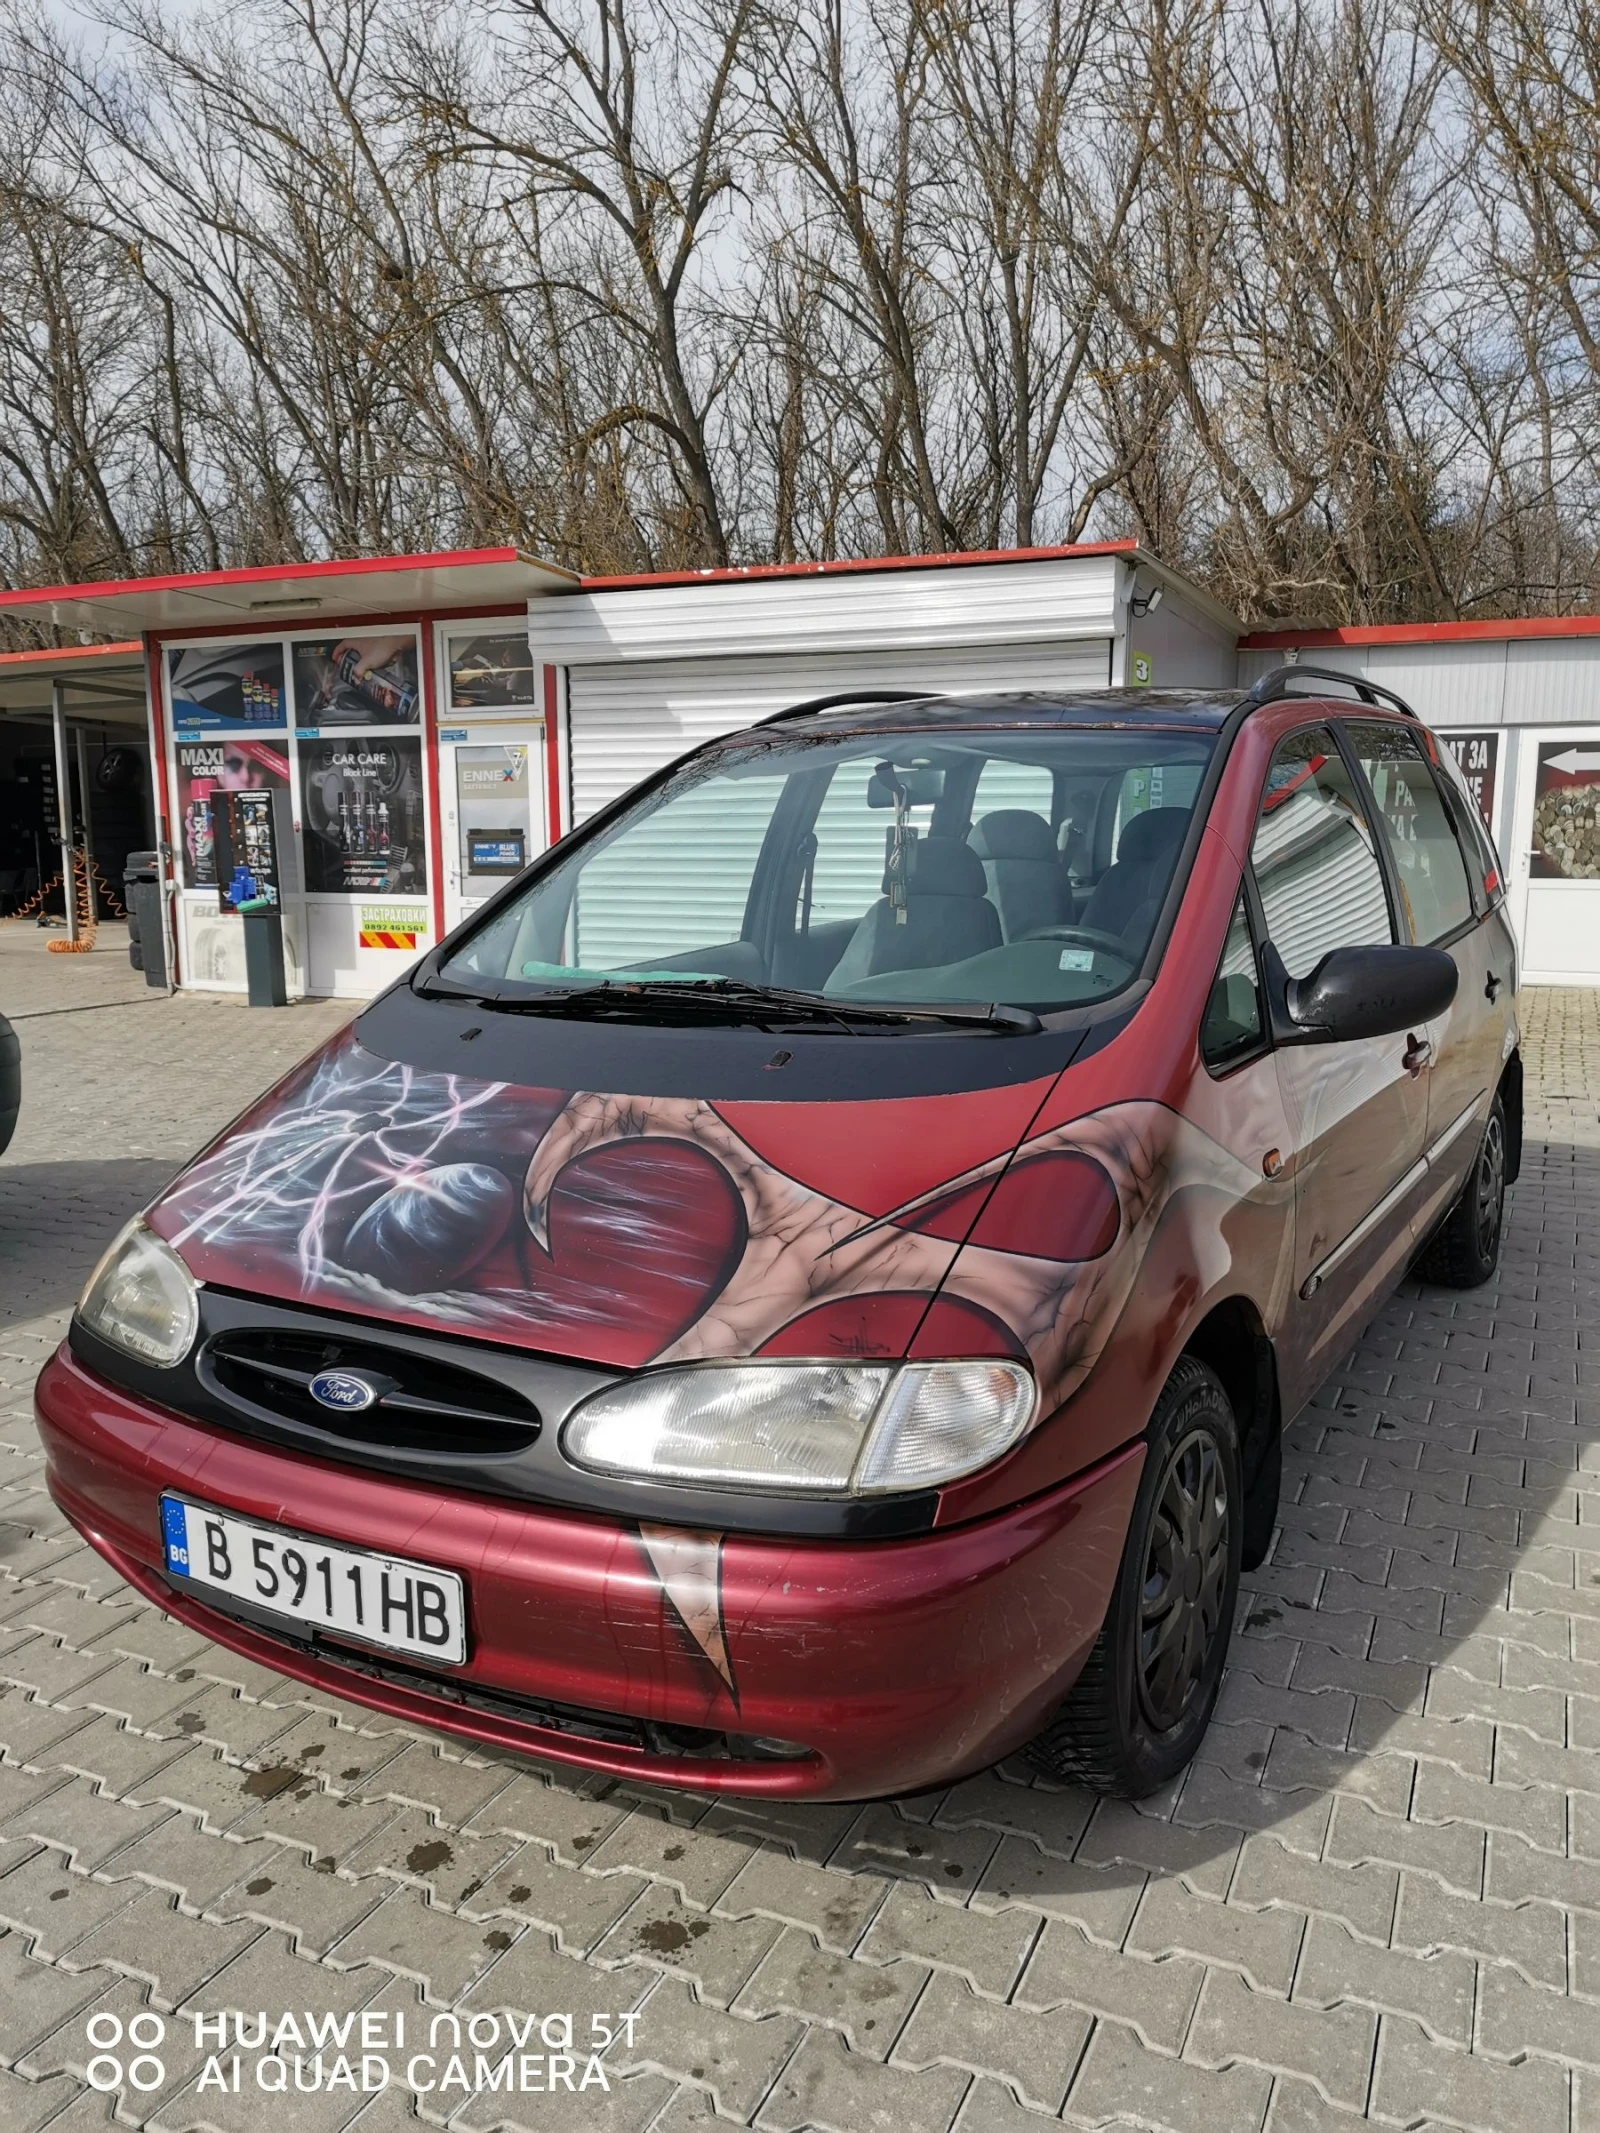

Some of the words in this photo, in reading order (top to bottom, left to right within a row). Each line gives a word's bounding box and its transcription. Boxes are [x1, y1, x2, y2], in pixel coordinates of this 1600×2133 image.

[181, 748, 224, 766] MAXI
[332, 753, 355, 765] CAR
[357, 753, 387, 765] CARE
[192, 766, 225, 776] COLOR
[343, 768, 361, 777] Black
[362, 768, 377, 777] Line
[362, 907, 427, 923] ЗАСТРАХОВКИ
[321, 1379, 358, 1403] Ford
[170, 1545, 188, 1565] BG
[204, 1520, 231, 1581] B
[252, 1537, 364, 1626] 5911
[380, 1571, 450, 1646] HB
